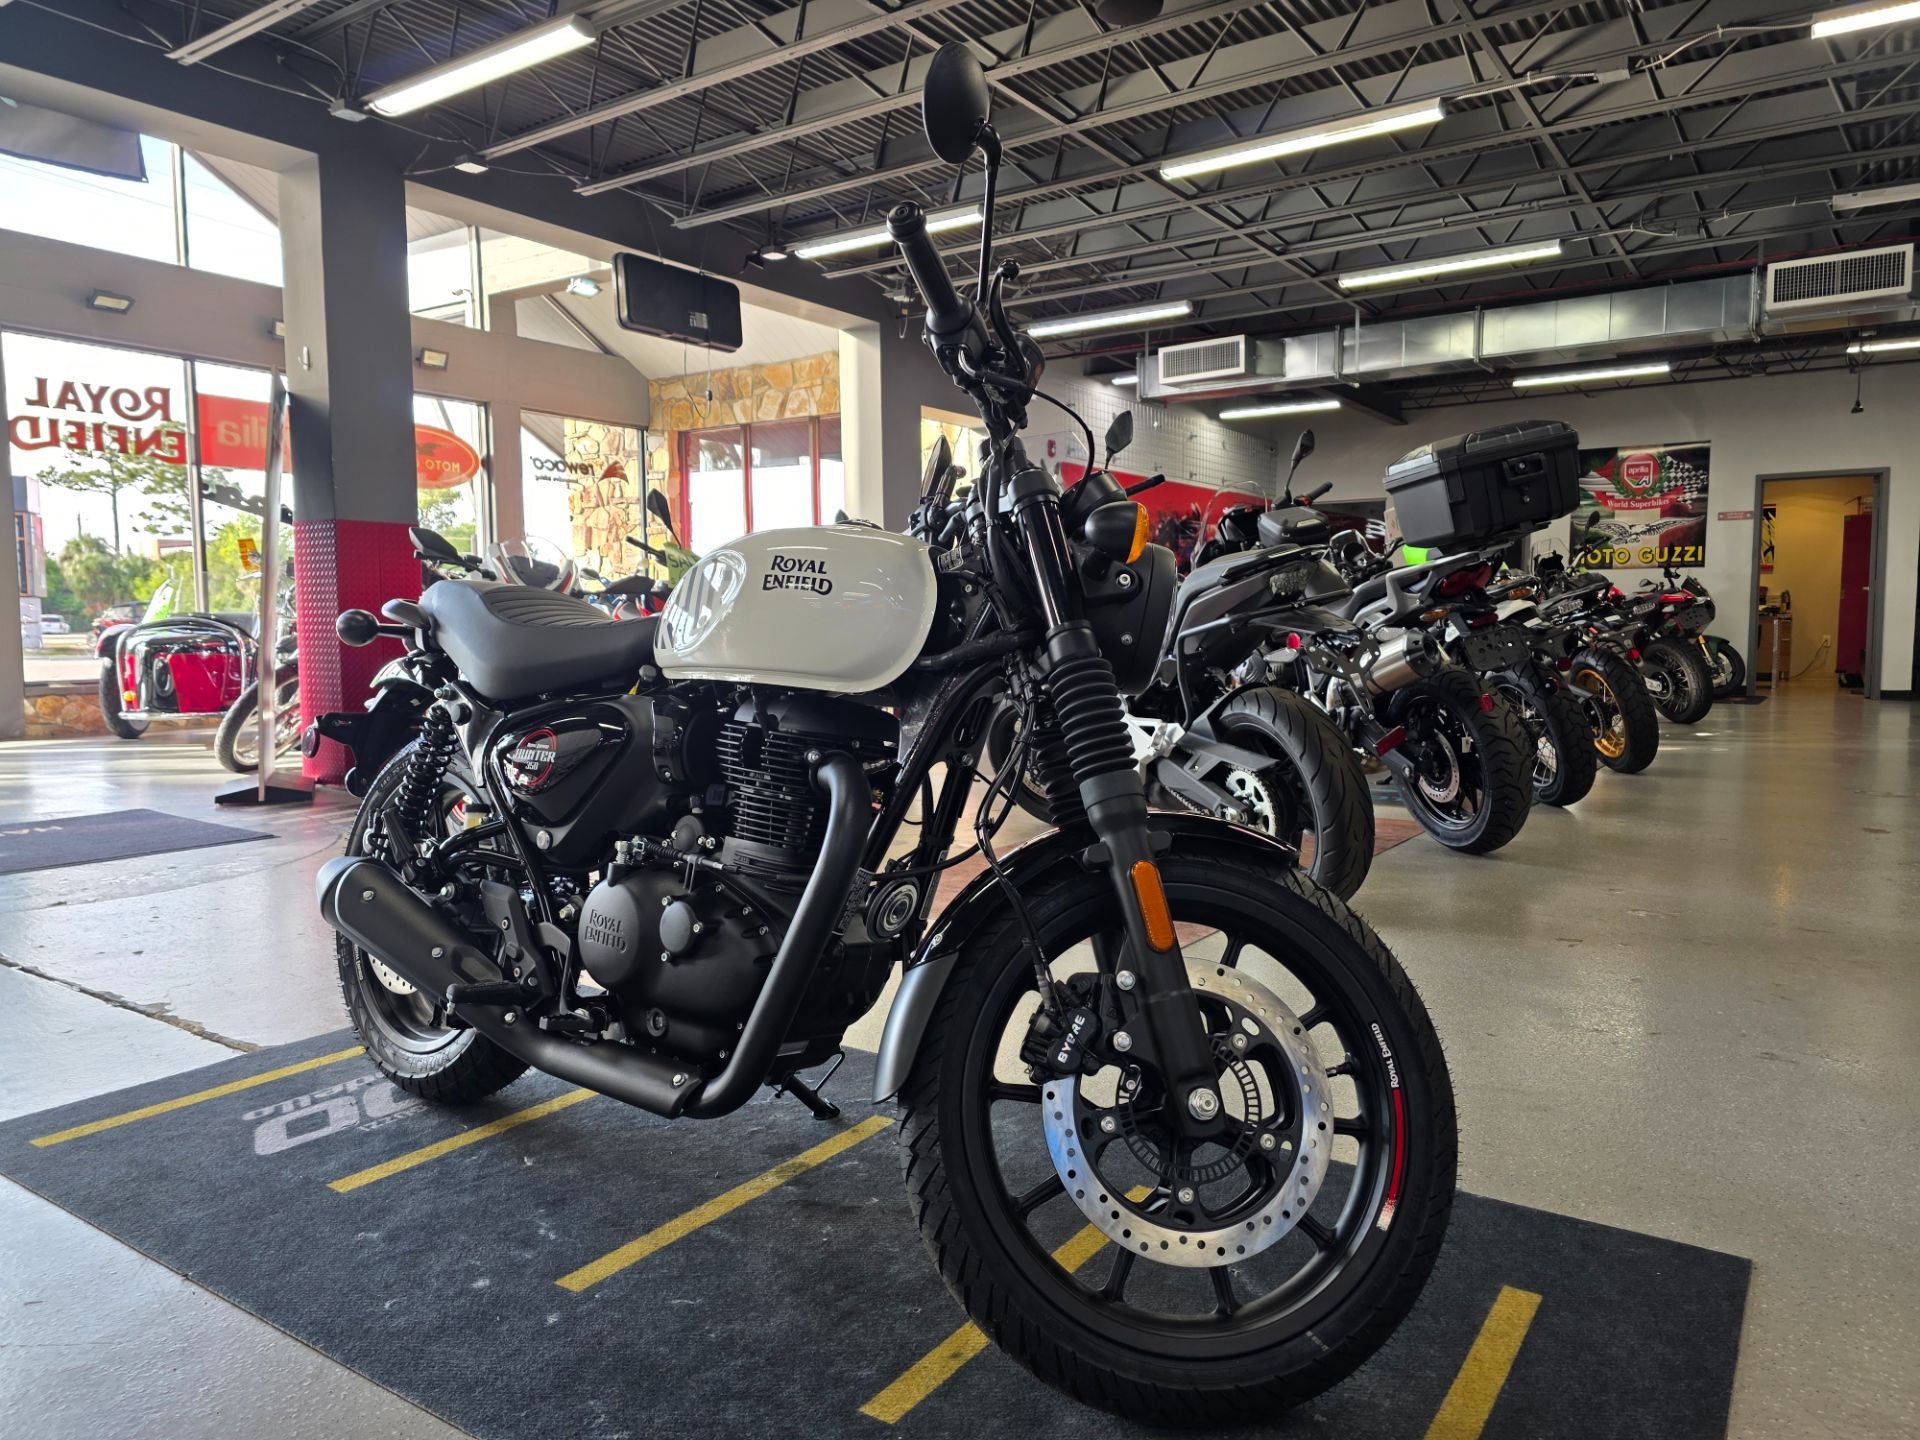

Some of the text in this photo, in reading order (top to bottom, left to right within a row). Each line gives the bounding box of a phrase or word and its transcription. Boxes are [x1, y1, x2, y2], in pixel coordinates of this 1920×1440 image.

[1628, 464, 1650, 475] aprilia
[1607, 498, 1669, 509] World Superbikes
[771, 555, 827, 574] ROYAL
[1581, 546, 1703, 565] OTO GUZZI
[762, 574, 833, 596] ENFIELD
[514, 748, 556, 763] HUNTER
[525, 761, 539, 770] 350
[589, 908, 623, 933] ROYAL
[584, 925, 628, 954] ENFIELD
[1057, 1014, 1086, 1064] BYBRE
[1371, 1023, 1400, 1088] ROYAL ENFIELD
